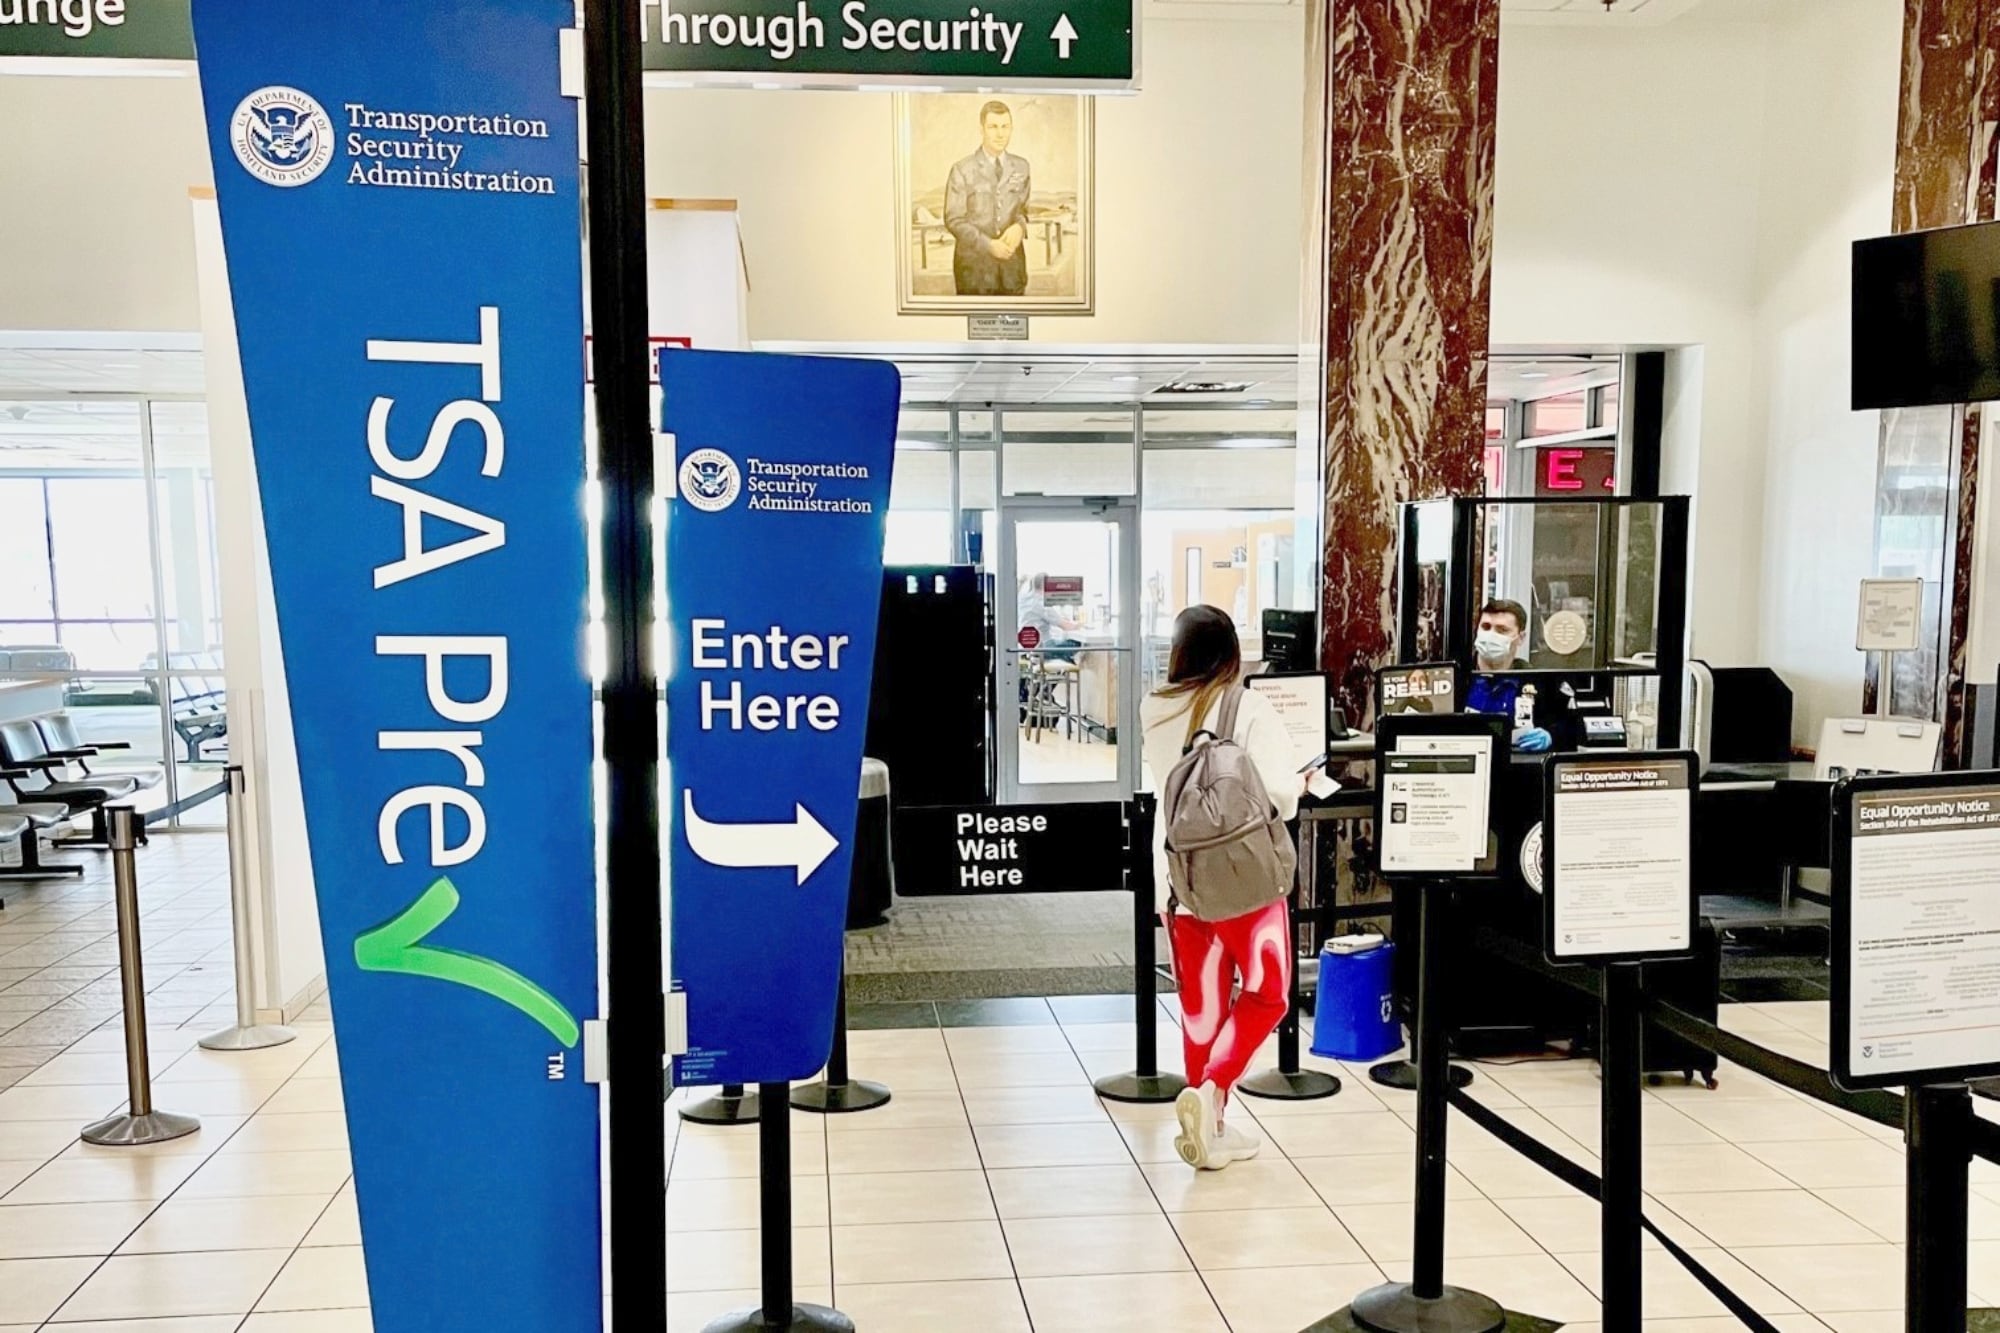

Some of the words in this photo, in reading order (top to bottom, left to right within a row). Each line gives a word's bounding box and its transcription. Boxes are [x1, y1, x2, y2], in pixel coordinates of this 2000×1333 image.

[641, 0, 824, 60] Through
[842, 1, 1023, 64] Security
[345, 103, 549, 138] Transportation
[237, 138, 286, 181] HOMELAND
[290, 144, 328, 180] SECURITY
[347, 133, 462, 168] Security
[347, 161, 555, 194] Administration
[366, 305, 506, 590] TSA
[747, 458, 869, 480] Transportation
[748, 476, 817, 498] Security
[748, 494, 872, 513] Administration
[692, 618, 849, 670] Enter
[1433, 680, 1452, 695] ID
[701, 681, 840, 731] Here
[375, 635, 509, 867] Pre
[1561, 773, 1583, 783] Equal
[1584, 772, 1632, 782] Opportunity
[1633, 770, 1658, 780] Notice
[957, 813, 1047, 835] Please
[1860, 806, 1889, 820] Equal
[1891, 803, 1955, 818] Opportunity
[1957, 800, 1990, 812] Notice
[957, 838, 1018, 861] Wait
[960, 865, 1023, 887] Here
[548, 1051, 564, 1080] TM
